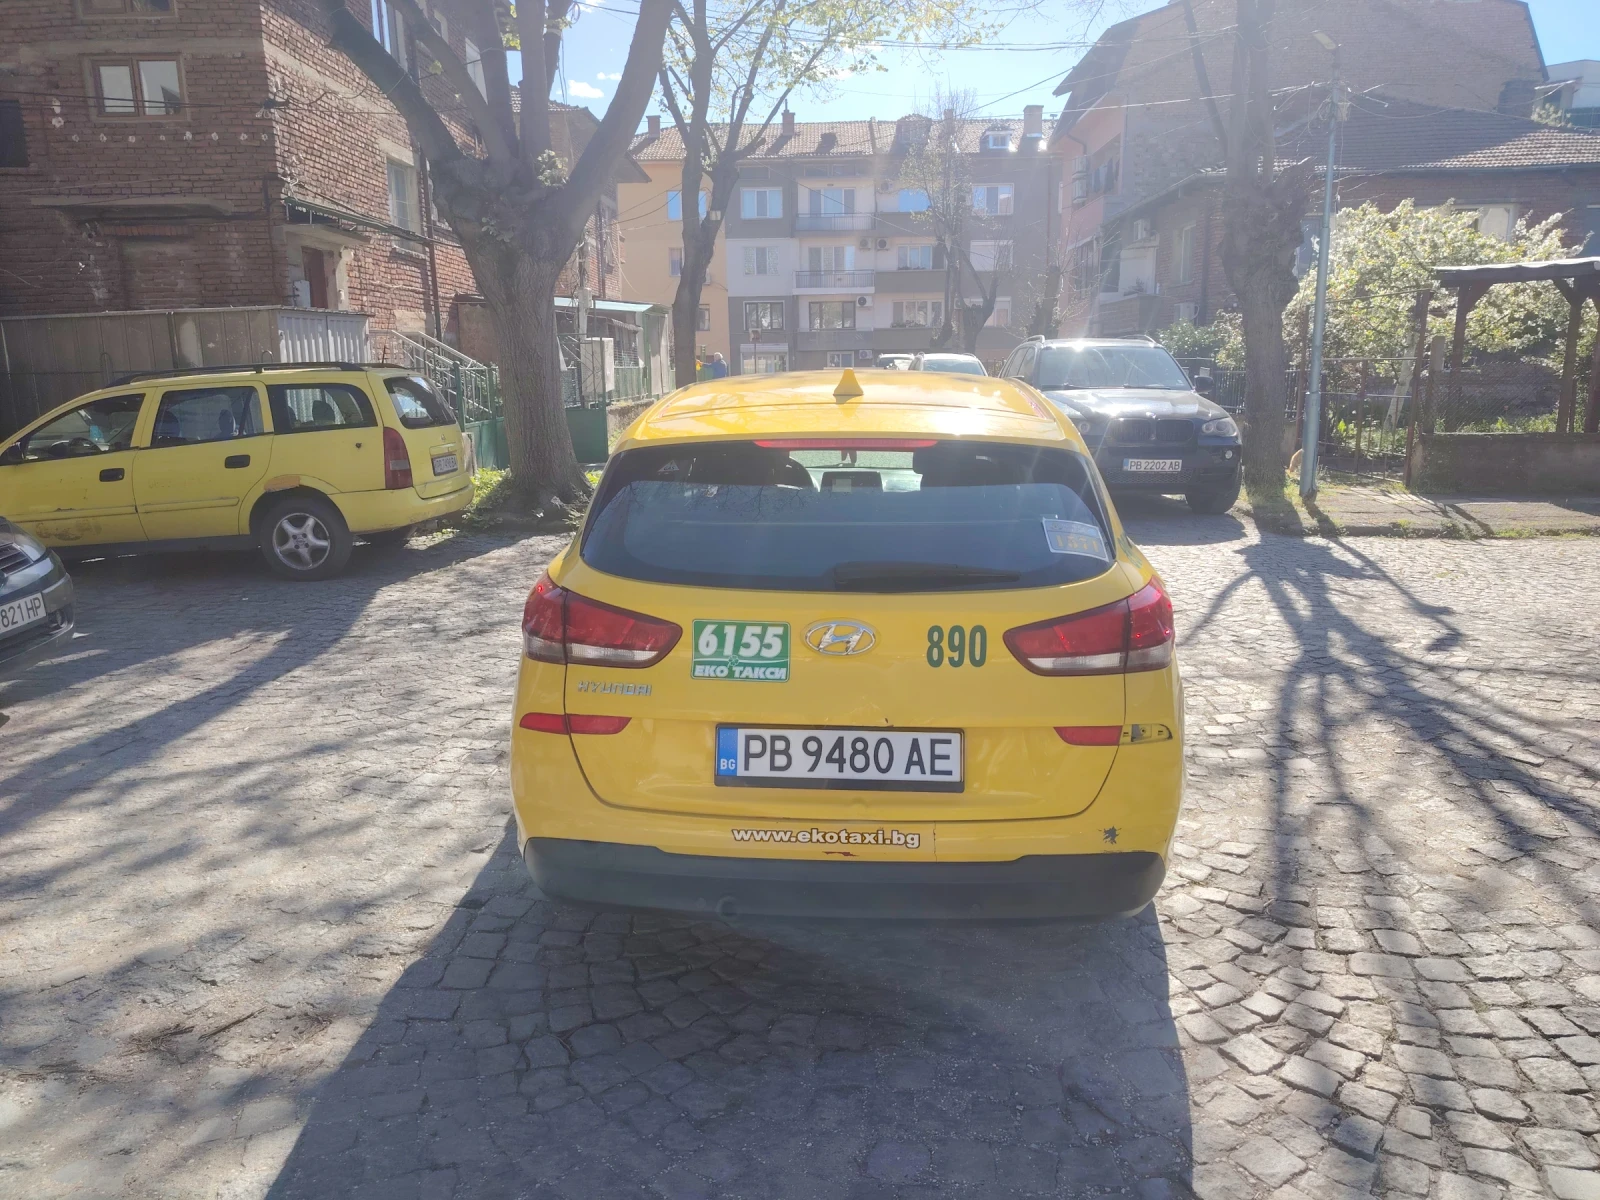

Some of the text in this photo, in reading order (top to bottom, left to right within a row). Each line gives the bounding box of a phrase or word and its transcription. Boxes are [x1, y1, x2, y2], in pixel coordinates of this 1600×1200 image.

[1129, 461, 1180, 470] PB 2202 AB
[0, 597, 41, 630] 821 HP
[698, 624, 784, 658] 6155
[926, 624, 987, 668] 890
[694, 665, 787, 680] ЕКО ТАКСИ
[577, 680, 652, 696] HYUNDAI
[720, 758, 736, 770] BG
[743, 734, 953, 776] PB 9480 AE
[731, 828, 920, 848] www.ekotaxi.bg
